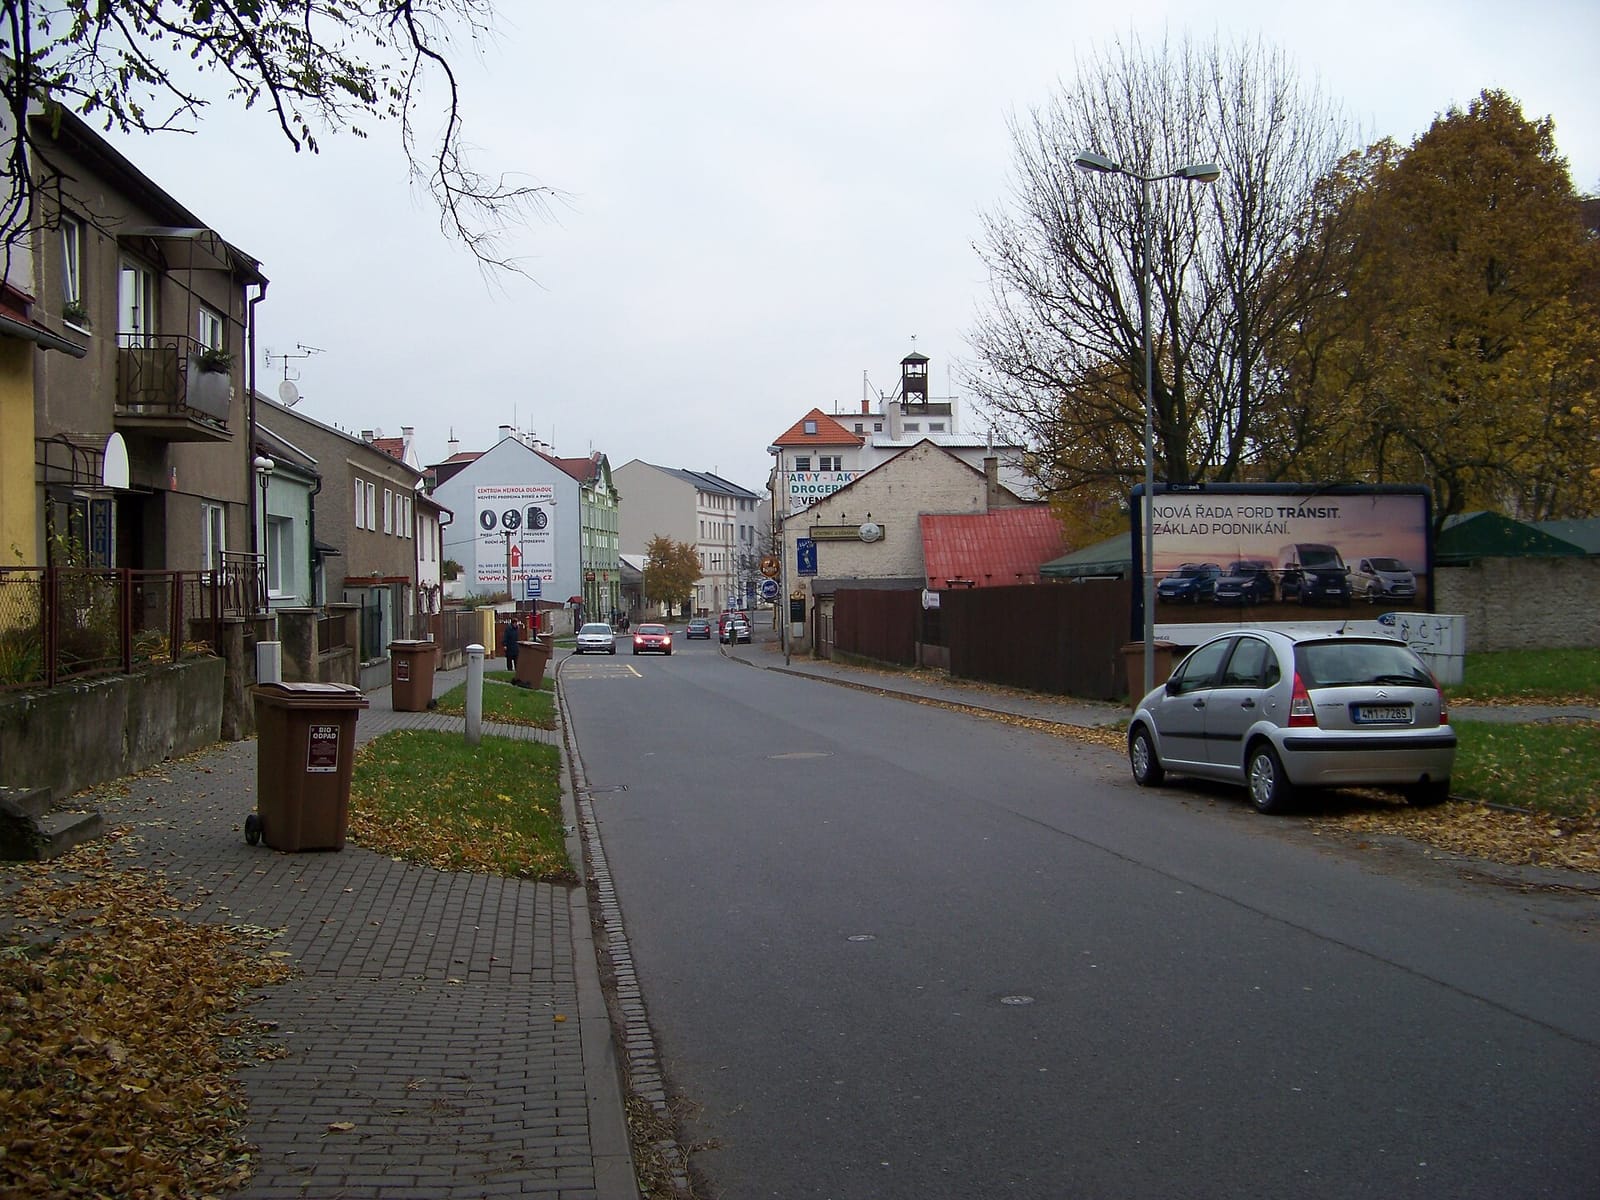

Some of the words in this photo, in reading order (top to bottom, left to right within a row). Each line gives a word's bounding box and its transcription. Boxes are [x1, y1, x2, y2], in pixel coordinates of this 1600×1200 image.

[784, 473, 820, 482] ARVY
[1153, 504, 1191, 518] NOVÁ
[1196, 504, 1233, 518] ŘADA
[1237, 507, 1273, 518] FORD
[1277, 507, 1341, 519] TRANSIT.
[1153, 522, 1209, 535] ZÁKLAD
[1213, 521, 1290, 535] PODNIKÁNÍ.
